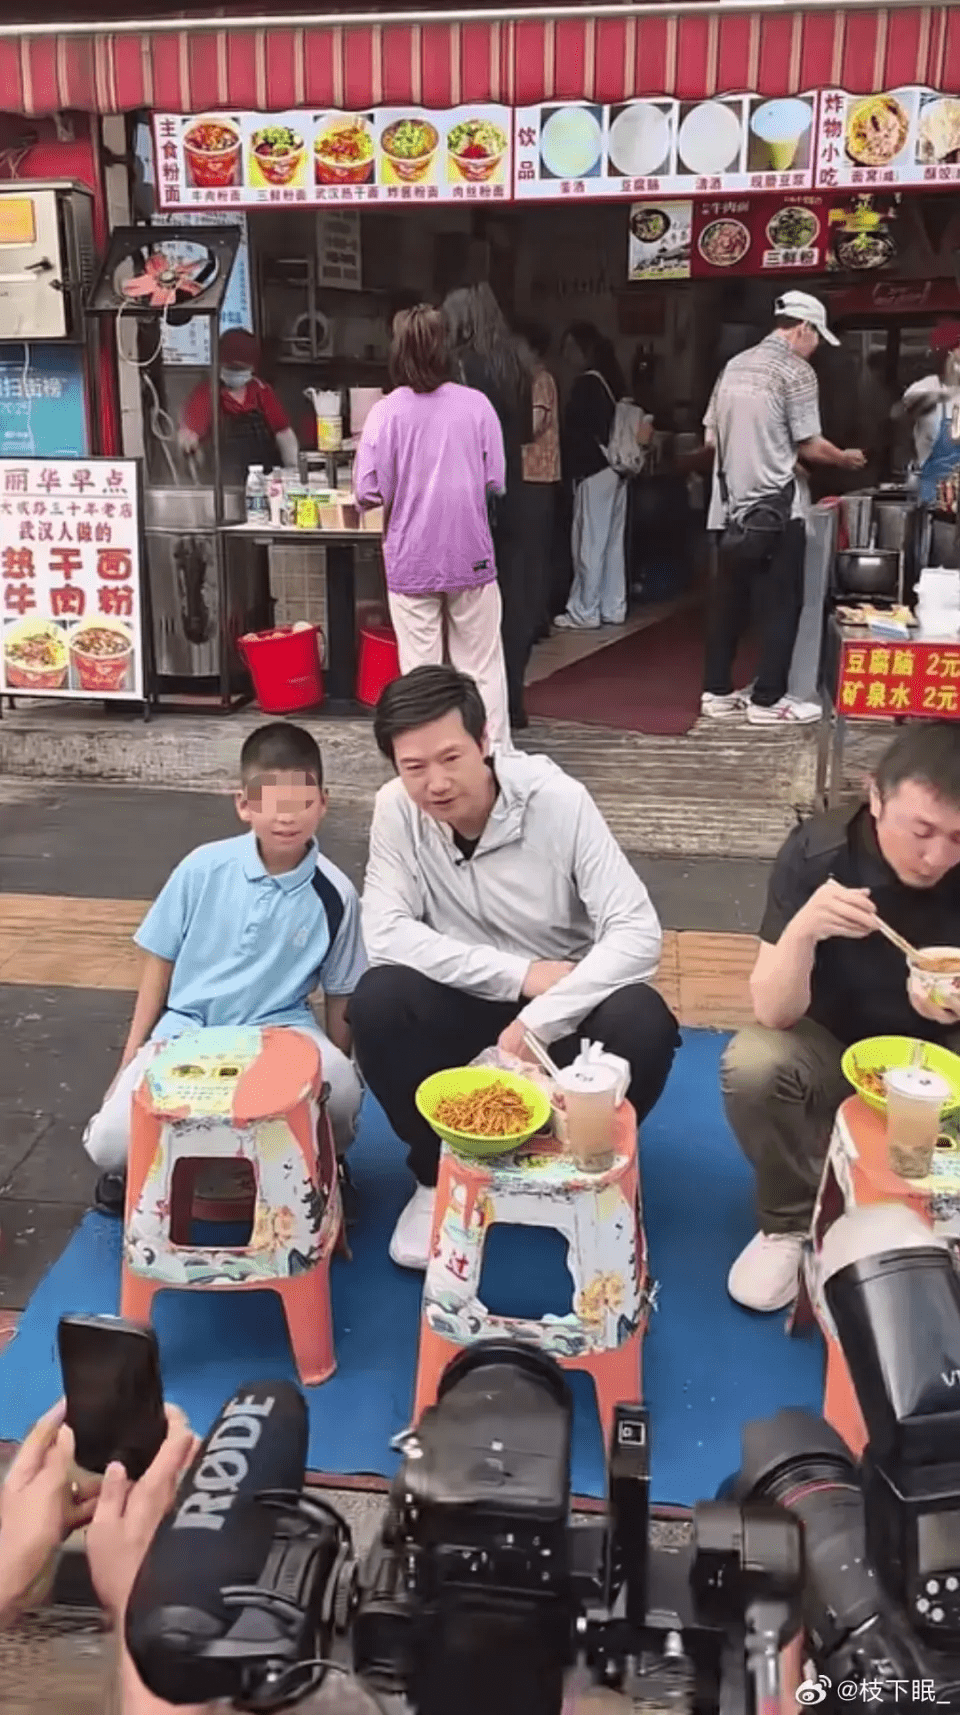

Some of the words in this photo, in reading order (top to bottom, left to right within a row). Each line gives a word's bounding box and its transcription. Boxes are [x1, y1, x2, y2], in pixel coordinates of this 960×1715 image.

[517, 127, 536, 181] 饮品
[818, 93, 845, 187] 炸物小吃
[159, 119, 181, 203] 主食粉面
[4, 466, 128, 495] 丽华早点
[19, 520, 112, 543] 武汉人做的
[2, 546, 133, 581] 热干面
[3, 582, 134, 617] 牛肉粉
[926, 652, 960, 679] 2元
[842, 679, 911, 709] 矿泉水
[922, 685, 959, 712] 2元
